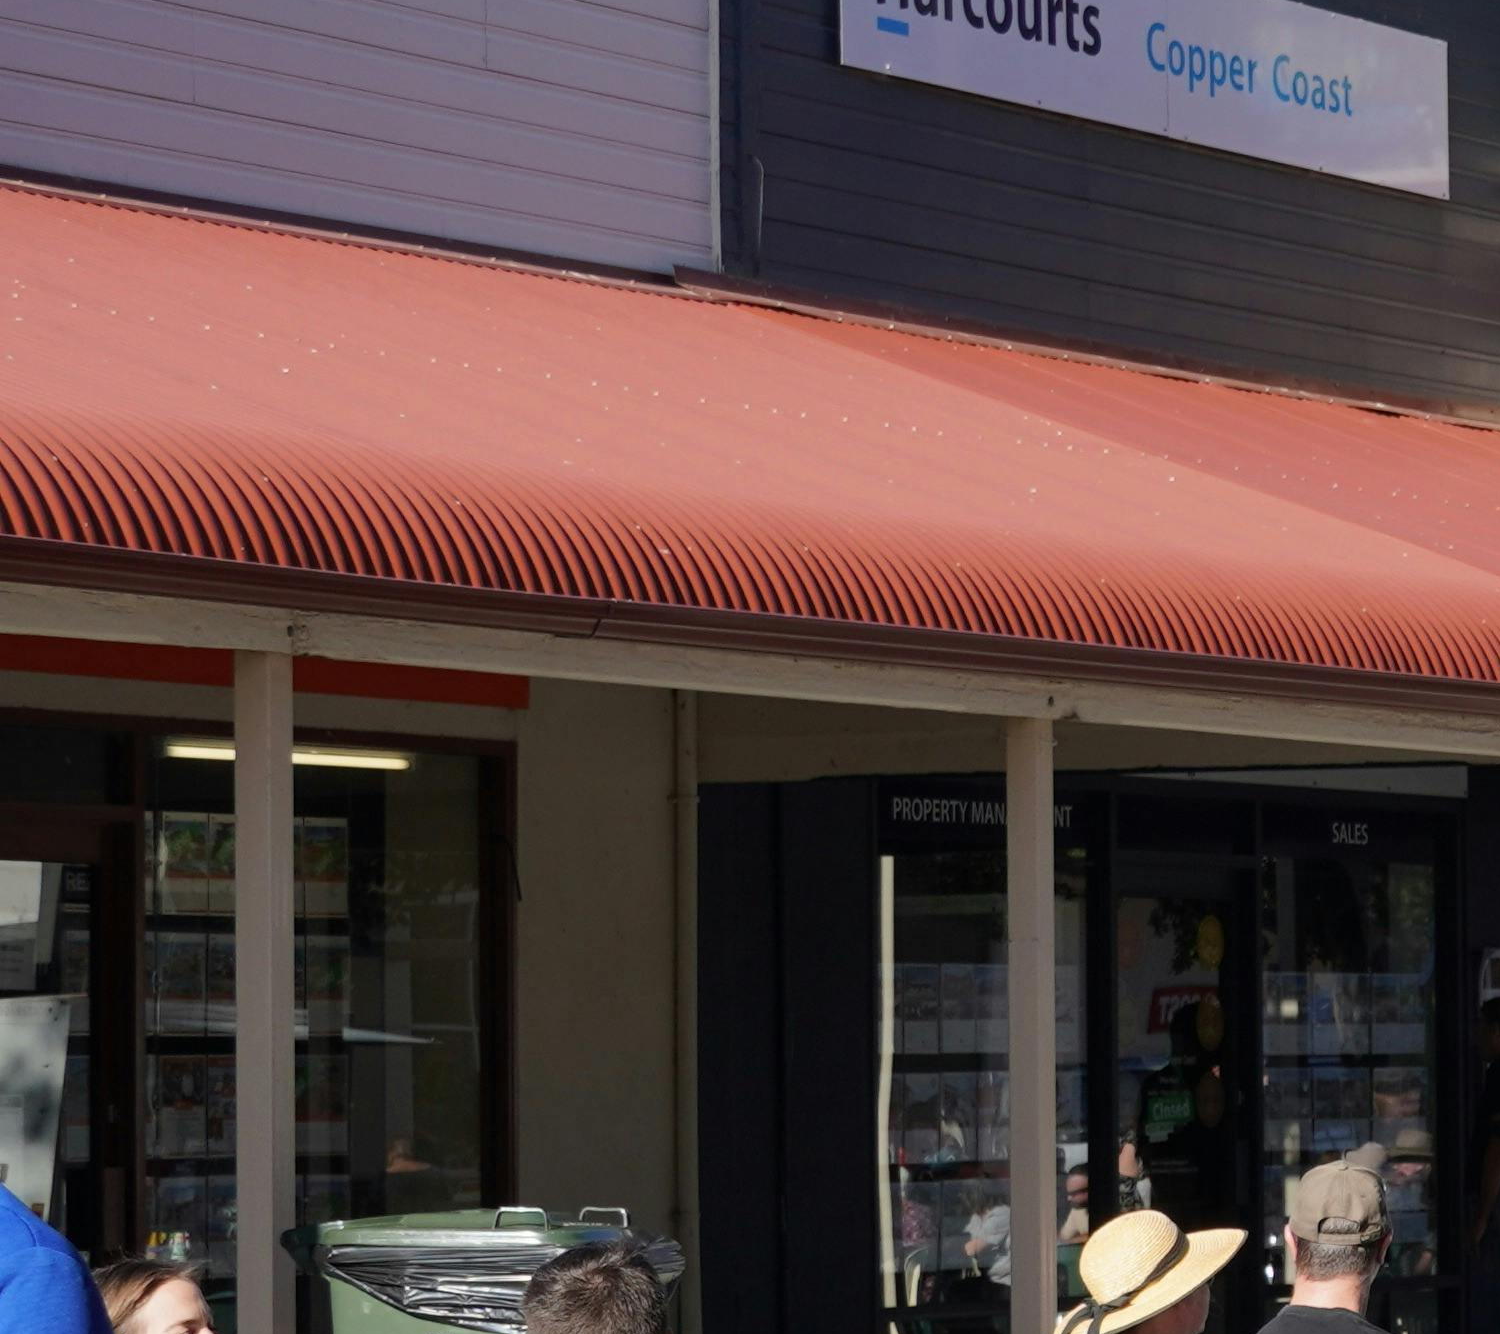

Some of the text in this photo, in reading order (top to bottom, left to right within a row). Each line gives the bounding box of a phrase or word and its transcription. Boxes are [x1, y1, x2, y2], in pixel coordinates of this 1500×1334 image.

[1146, 23, 1353, 117] Copper Coast
[892, 797, 1073, 829] PROPERTY MANNT
[1332, 821, 1369, 846] SALES
[1152, 1098, 1191, 1121] Closed
